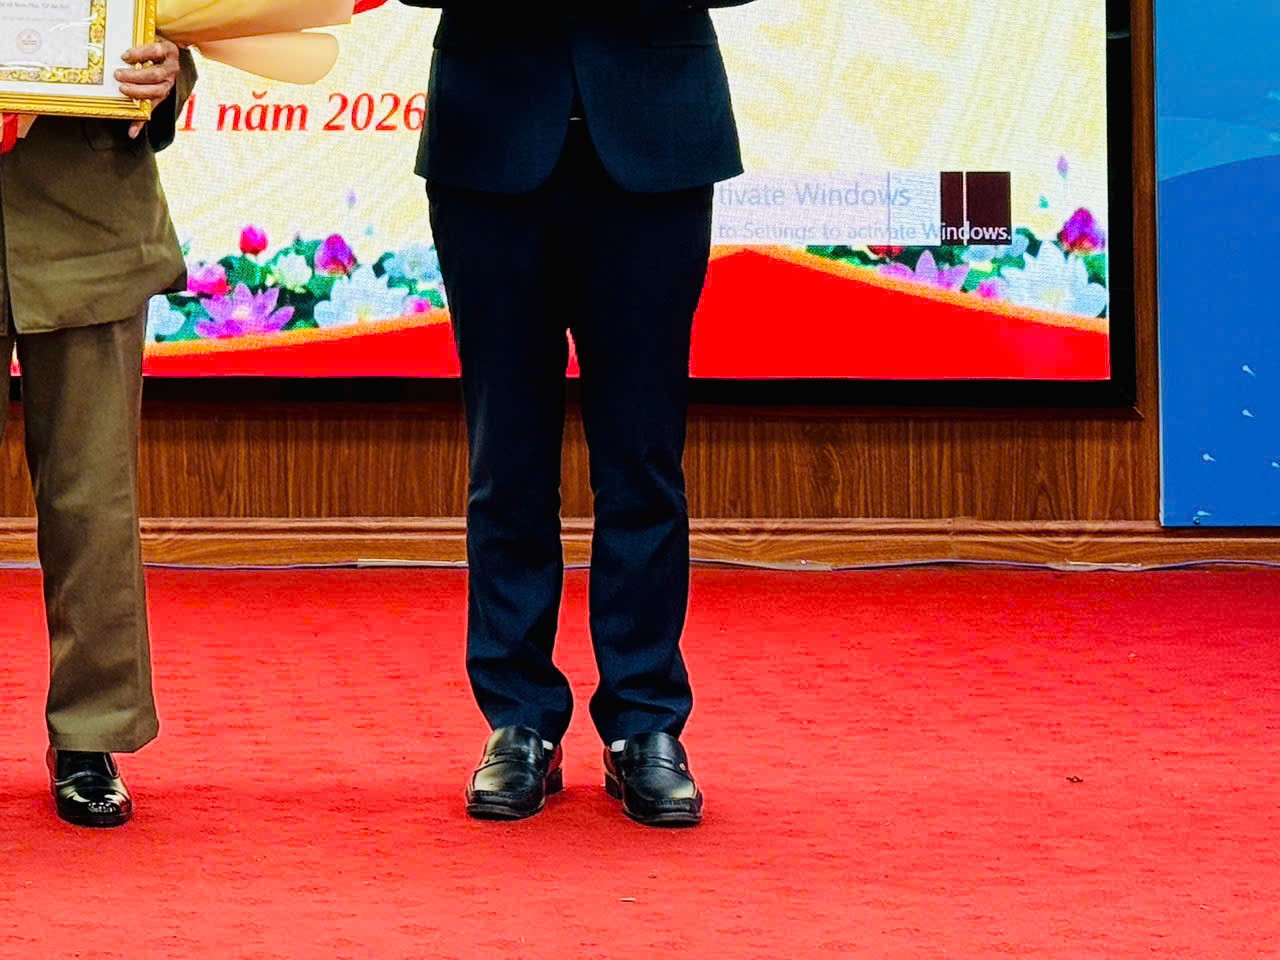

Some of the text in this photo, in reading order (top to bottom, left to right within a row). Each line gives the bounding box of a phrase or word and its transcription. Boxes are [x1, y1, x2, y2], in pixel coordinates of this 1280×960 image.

[217, 90, 309, 132] năm
[323, 92, 428, 132] 2026
[720, 183, 911, 206] tivate Windows
[720, 220, 1011, 244] to Settings to activate Windows.
